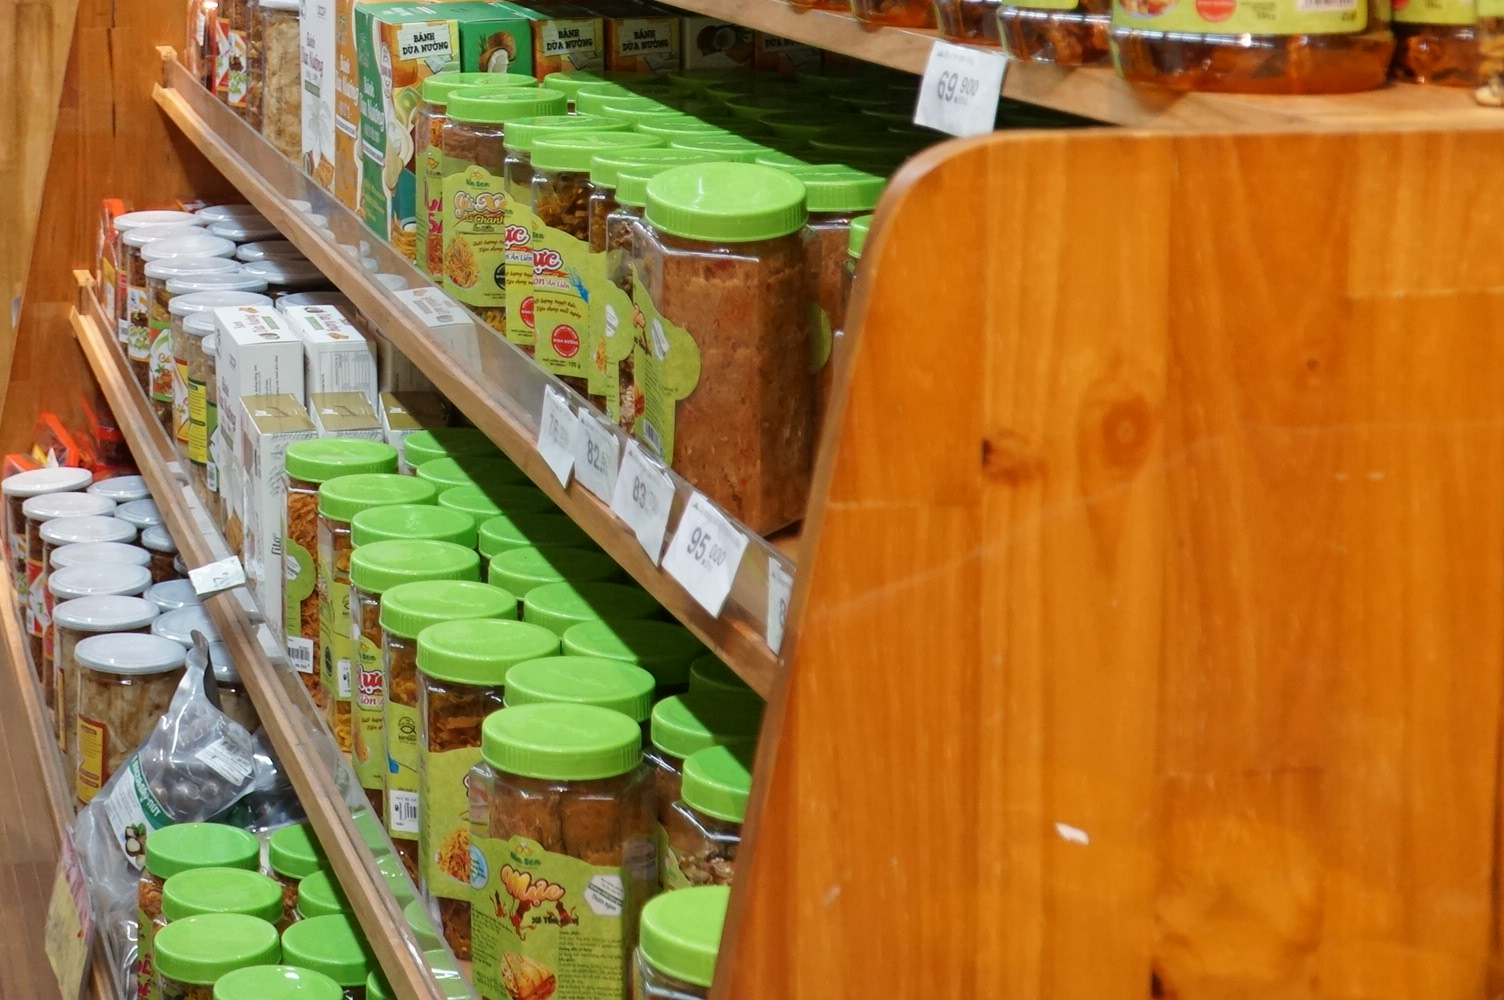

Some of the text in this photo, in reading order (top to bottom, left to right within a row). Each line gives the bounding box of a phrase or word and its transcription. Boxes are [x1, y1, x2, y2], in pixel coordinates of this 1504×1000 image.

[413, 32, 435, 43] BÁNH
[558, 27, 580, 39] BÁNH
[633, 28, 656, 39] BÁNH
[402, 40, 449, 55] DỪA NƯỚNG
[546, 37, 593, 51] DỪA NƯỚNG
[622, 37, 669, 52] DỪA NƯỚNG
[505, 224, 531, 250] ực
